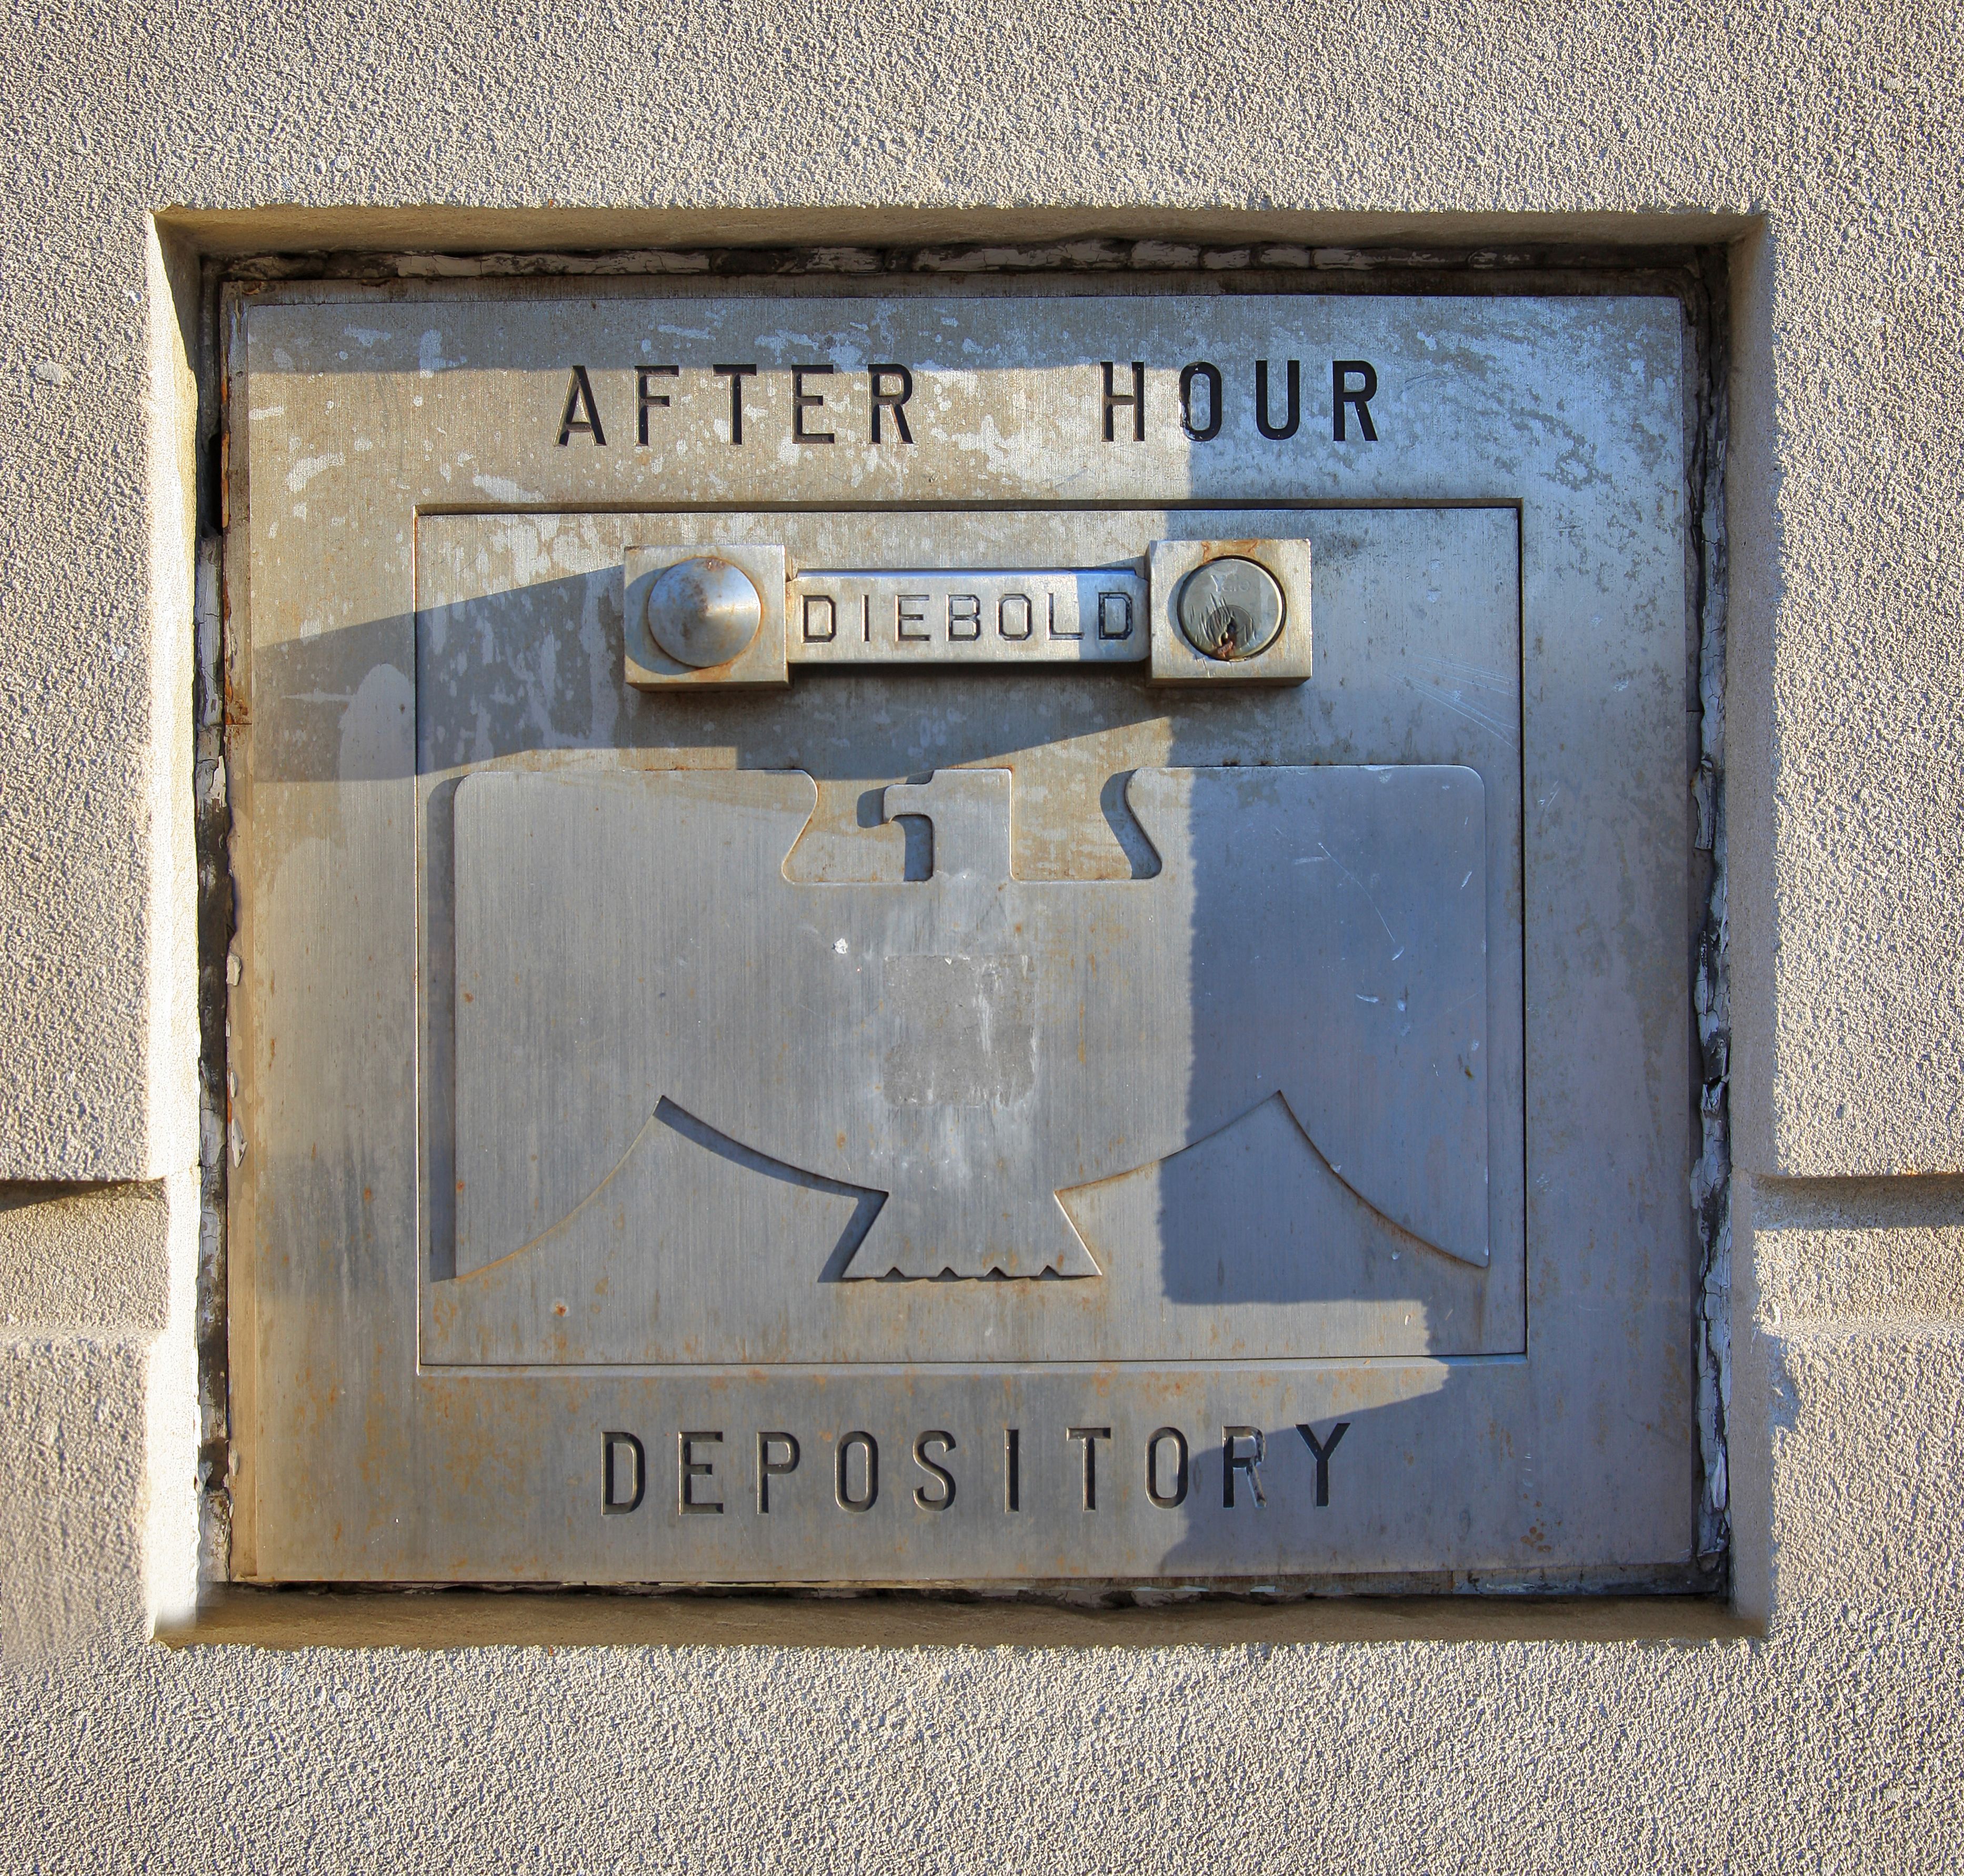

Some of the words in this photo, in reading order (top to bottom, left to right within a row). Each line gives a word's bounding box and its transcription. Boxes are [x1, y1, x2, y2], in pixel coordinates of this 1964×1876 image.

[554, 363, 914, 446] AFTER
[1100, 360, 1378, 442] HOUR
[800, 593, 1134, 642] DIEBOLD
[600, 1422, 1350, 1515] DEPOSITORY
